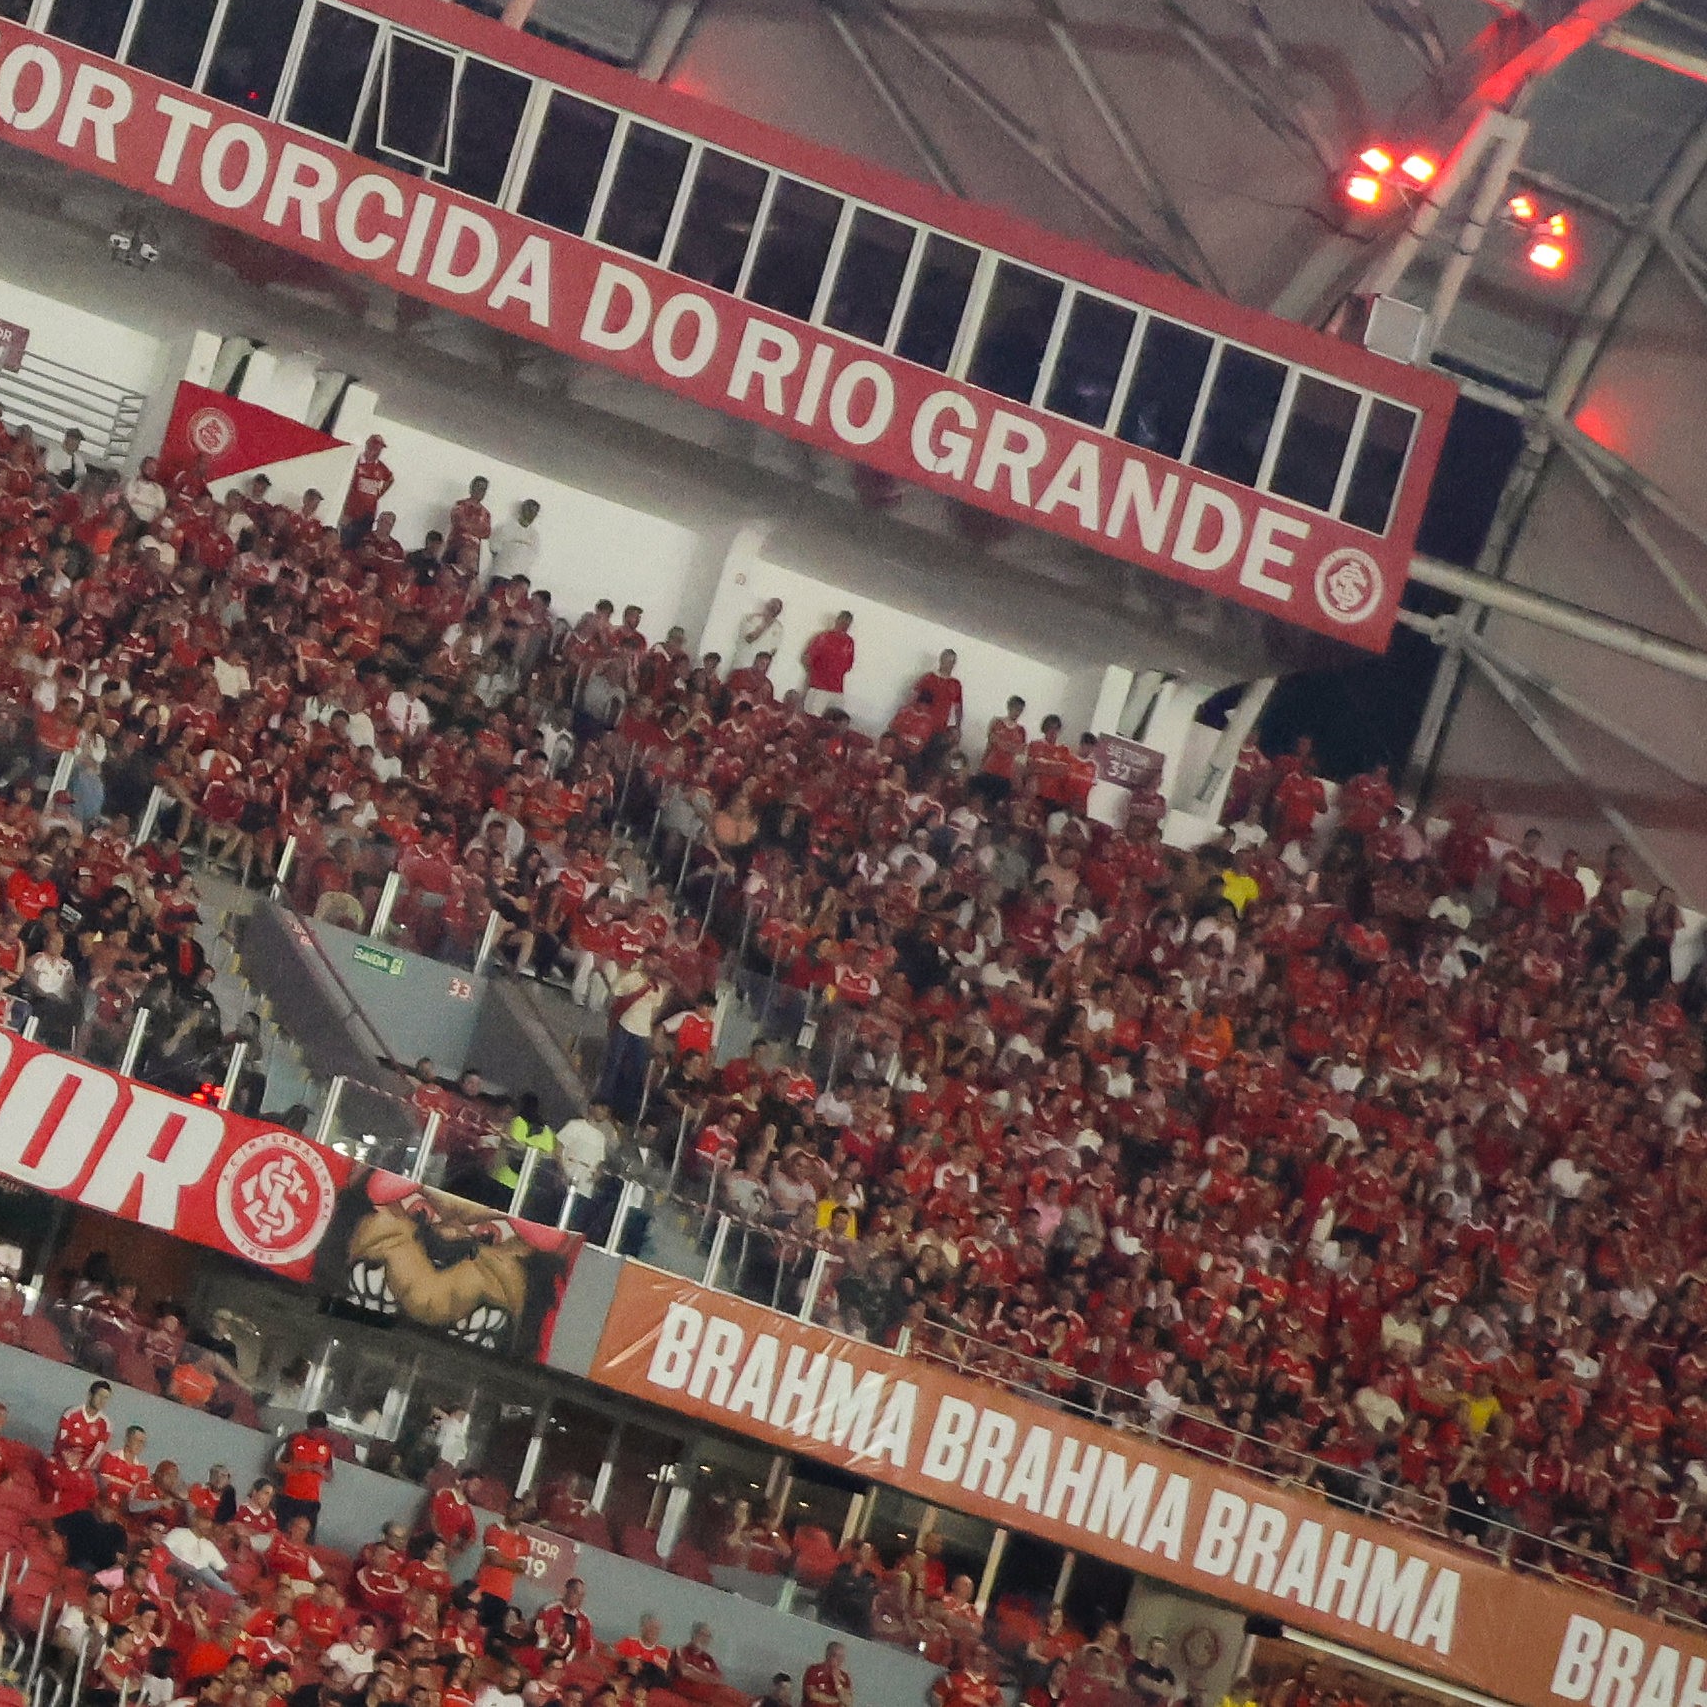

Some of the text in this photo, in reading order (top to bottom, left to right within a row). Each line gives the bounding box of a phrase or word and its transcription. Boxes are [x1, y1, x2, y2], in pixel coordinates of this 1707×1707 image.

[155, 95, 550, 327] TORCIDA
[581, 262, 718, 377] DO
[727, 318, 894, 444] RIO
[912, 391, 1310, 600] GRANDE
[527, 1535, 561, 1560] TOR
[648, 1296, 920, 1468] BRAHMA
[920, 1394, 1192, 1562] BRAHMA
[1193, 1488, 1461, 1655] BRAHMA
